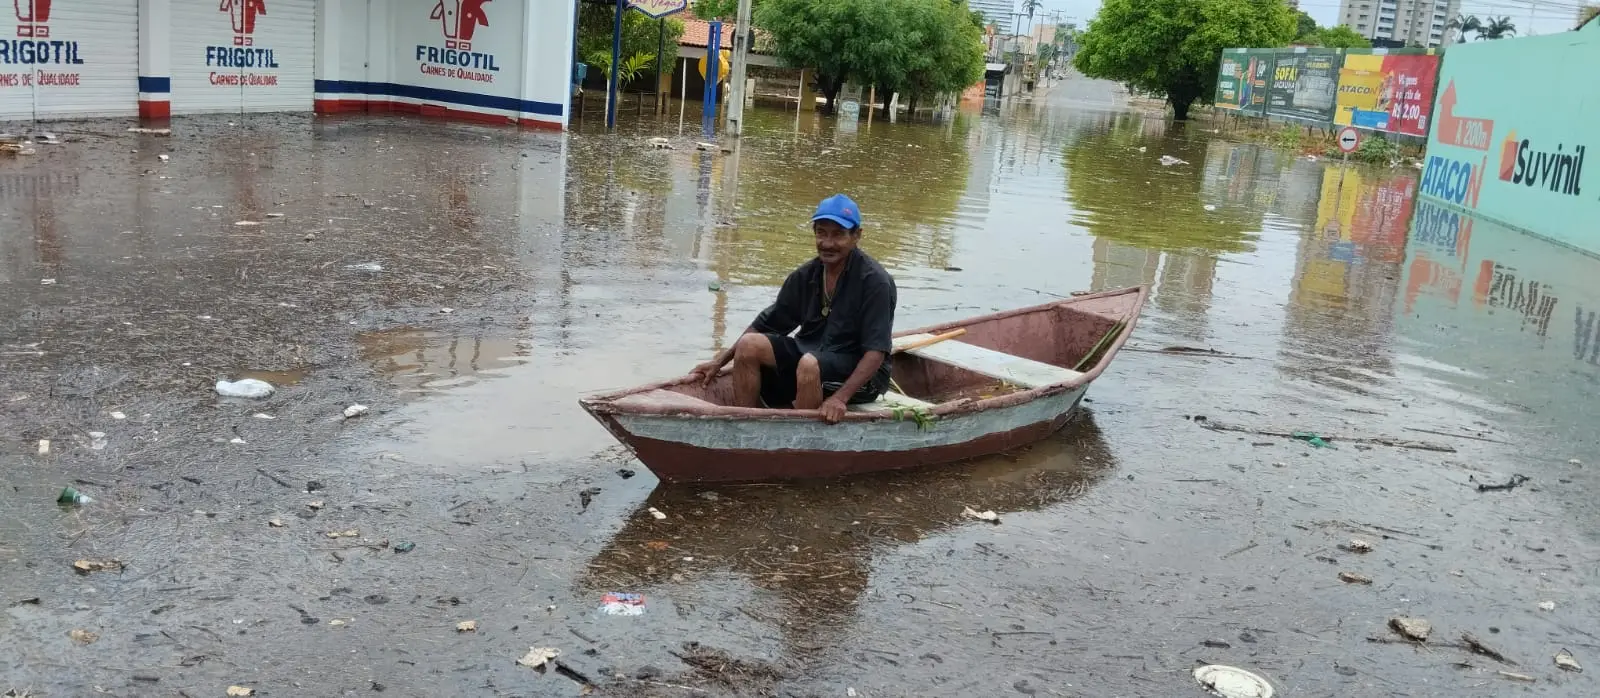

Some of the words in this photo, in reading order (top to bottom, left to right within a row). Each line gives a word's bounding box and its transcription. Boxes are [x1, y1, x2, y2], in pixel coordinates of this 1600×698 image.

[206, 46, 279, 68] FRIGOTIL
[416, 45, 500, 71] FRIGOTIL
[1420, 155, 1487, 209] ATACON
[1512, 138, 1586, 196] Suvinil
